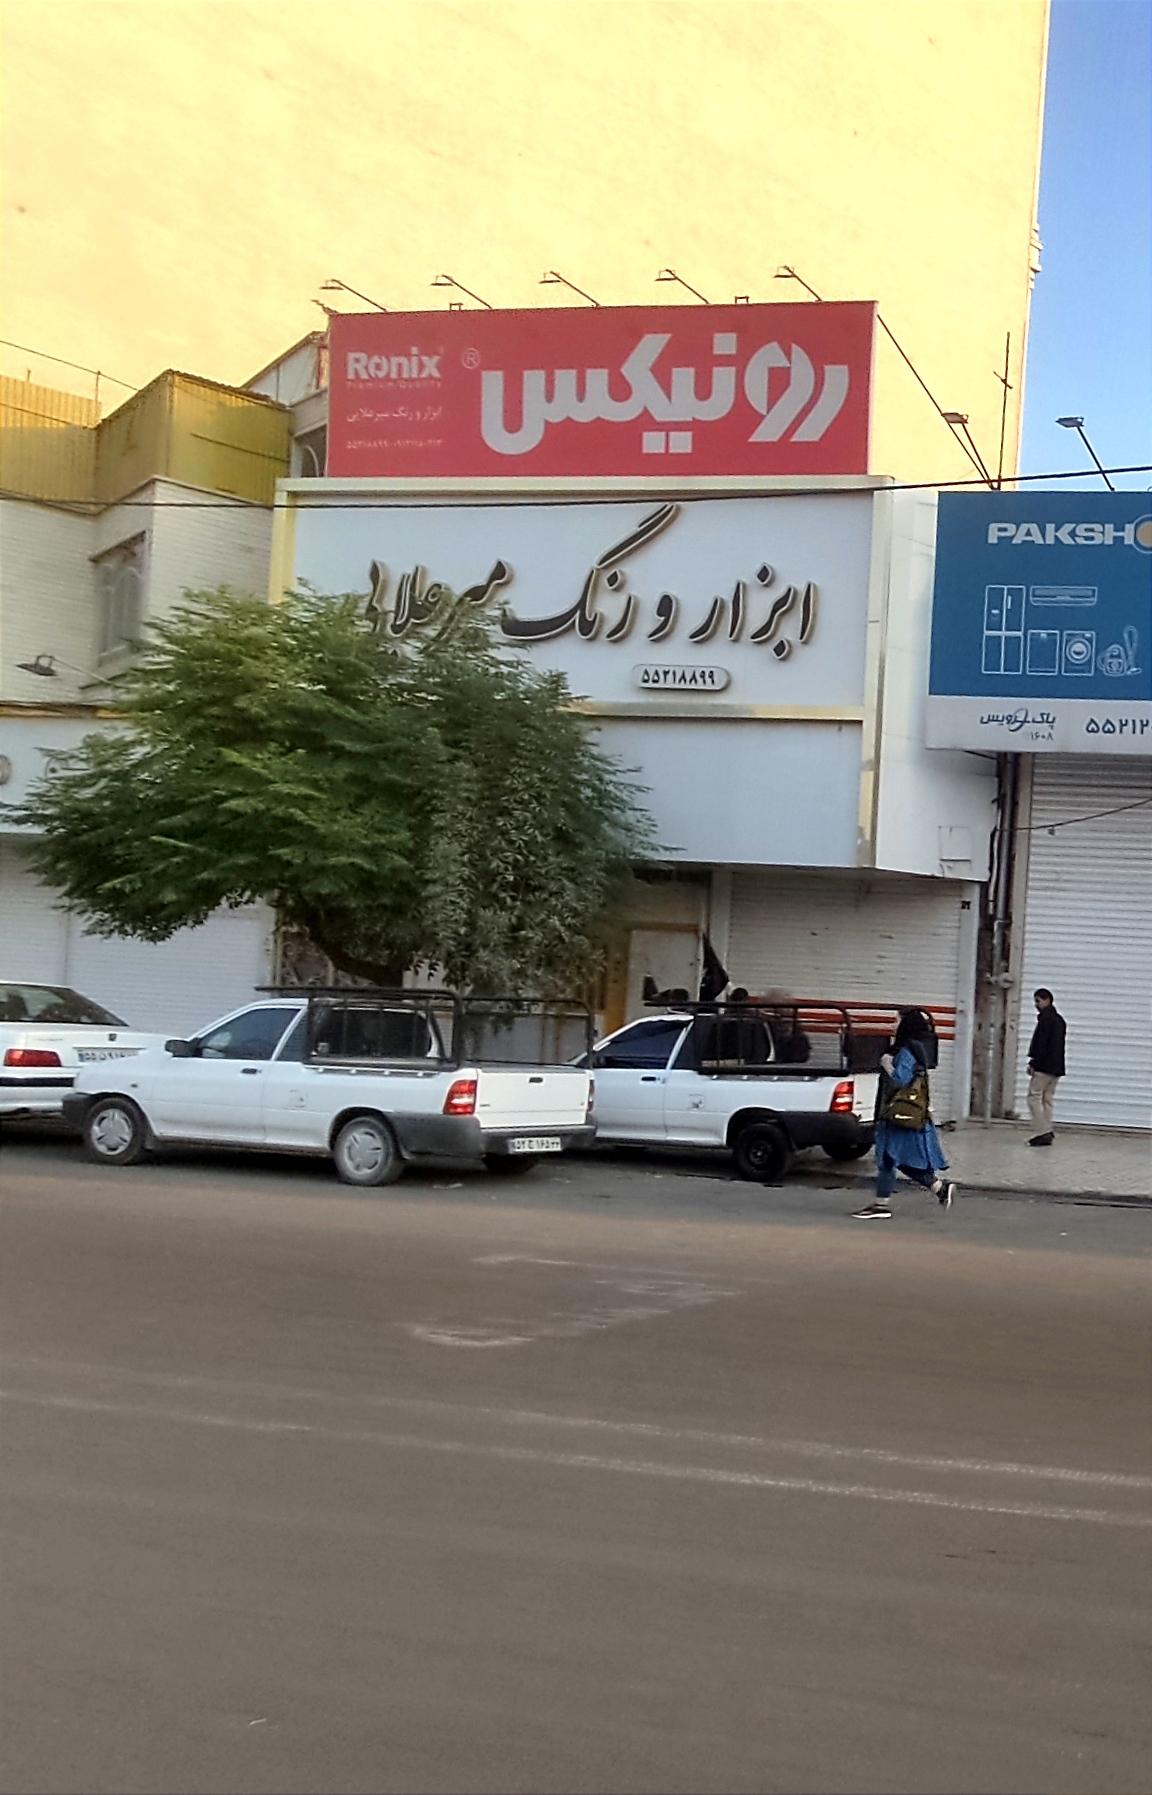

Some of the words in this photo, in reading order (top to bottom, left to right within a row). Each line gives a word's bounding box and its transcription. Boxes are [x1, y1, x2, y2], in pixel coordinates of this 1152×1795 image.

[346, 346, 441, 380] Ronix
[481, 332, 849, 455] رونیکس
[647, 593, 677, 642] و
[689, 562, 815, 660] ابزار
